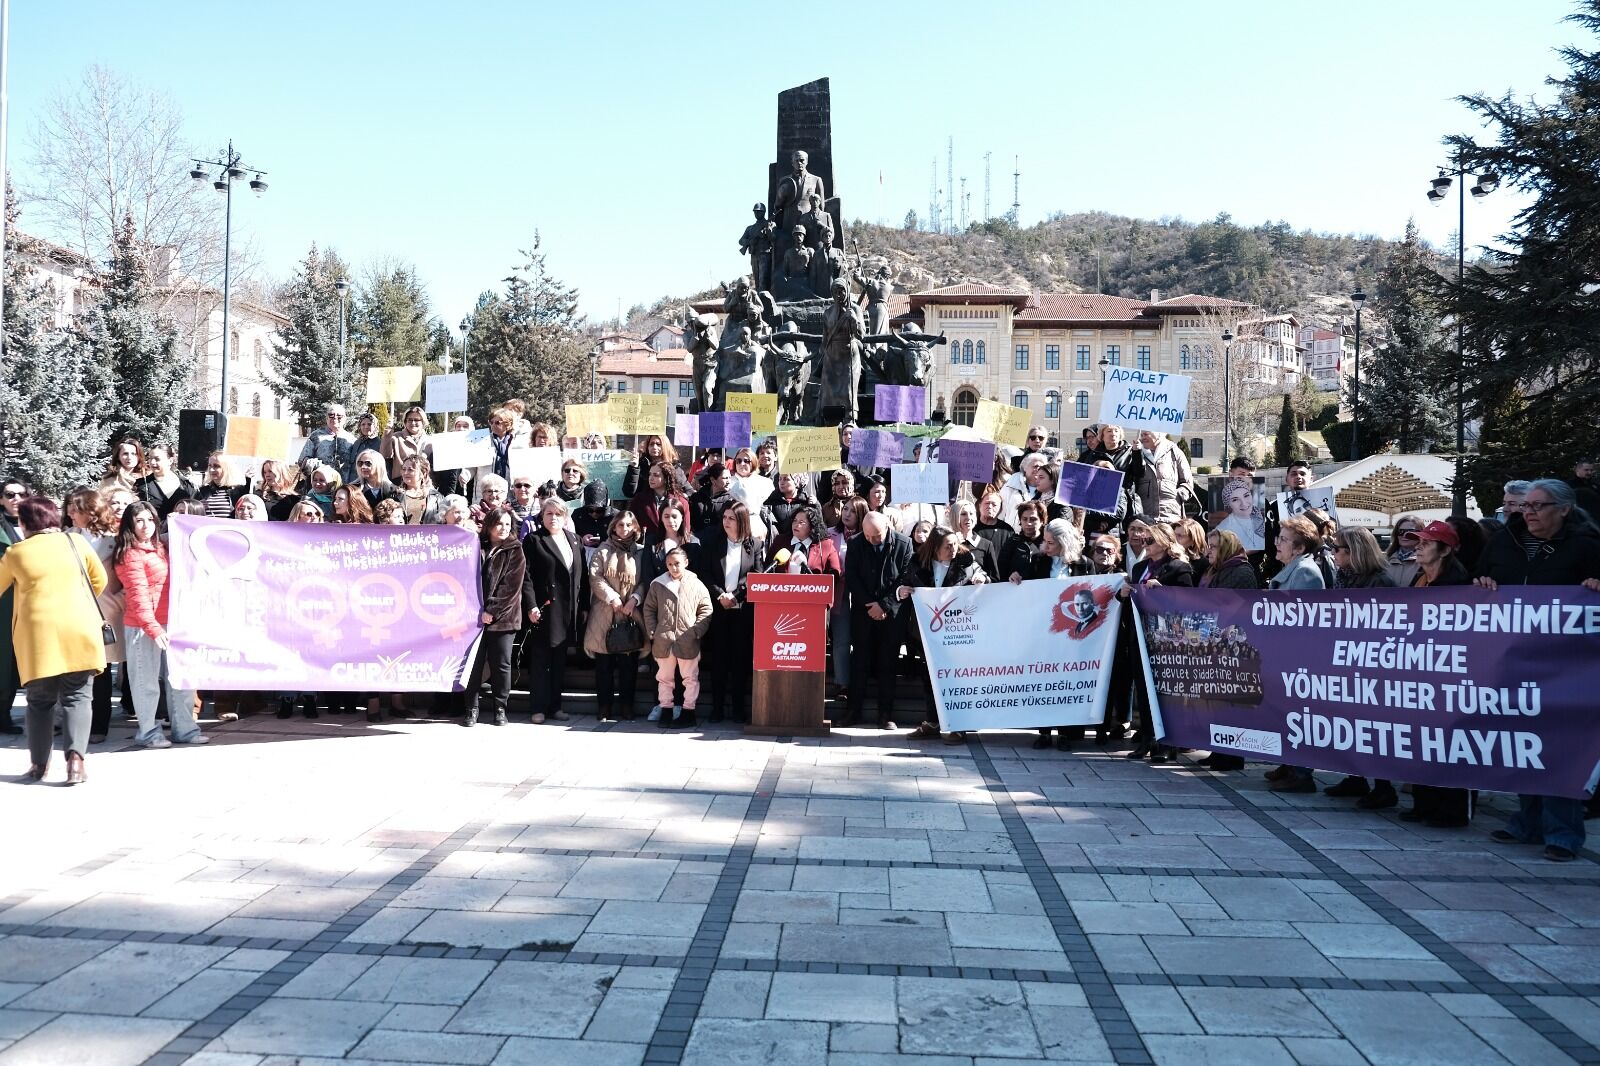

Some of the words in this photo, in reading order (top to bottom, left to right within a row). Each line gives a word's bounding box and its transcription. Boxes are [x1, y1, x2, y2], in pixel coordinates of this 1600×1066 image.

[1109, 369, 1169, 385] ADALET
[1128, 388, 1167, 403] YARIM
[1115, 404, 1184, 423] KALMASIN
[362, 537, 385, 551] Var
[390, 532, 439, 548] Oldukça
[751, 583, 769, 592] CHP
[770, 585, 830, 593] KASTAMONU
[944, 609, 962, 618] CHP
[944, 616, 973, 625] KADIN
[1251, 597, 1415, 636] CİNSİYETİMİZE,
[1421, 598, 1600, 635] BEDENİMİZE
[945, 624, 979, 633] KOLLARI
[772, 642, 807, 655] CHP
[1332, 637, 1468, 674] EMEĞİMİZE
[1218, 654, 1240, 668] için
[937, 668, 952, 680] EY
[954, 664, 1025, 679] KAHRAMAN
[1028, 660, 1060, 674] TÜRK
[1161, 668, 1190, 680] devlet
[949, 686, 978, 697] YERDE
[981, 682, 1042, 694] SÜRÜNMEYE
[1174, 682, 1185, 692] de
[1281, 667, 1379, 706] YÖNELİK
[1384, 681, 1435, 711] HER
[1441, 680, 1542, 717] TÜRLÜ
[975, 697, 1019, 709] GÖKLERE
[1021, 694, 1085, 707] YÜKSELMEYE
[1213, 733, 1235, 745] CHP
[1285, 706, 1413, 761] ŞİDDETE
[1420, 726, 1546, 770] HAYIR
